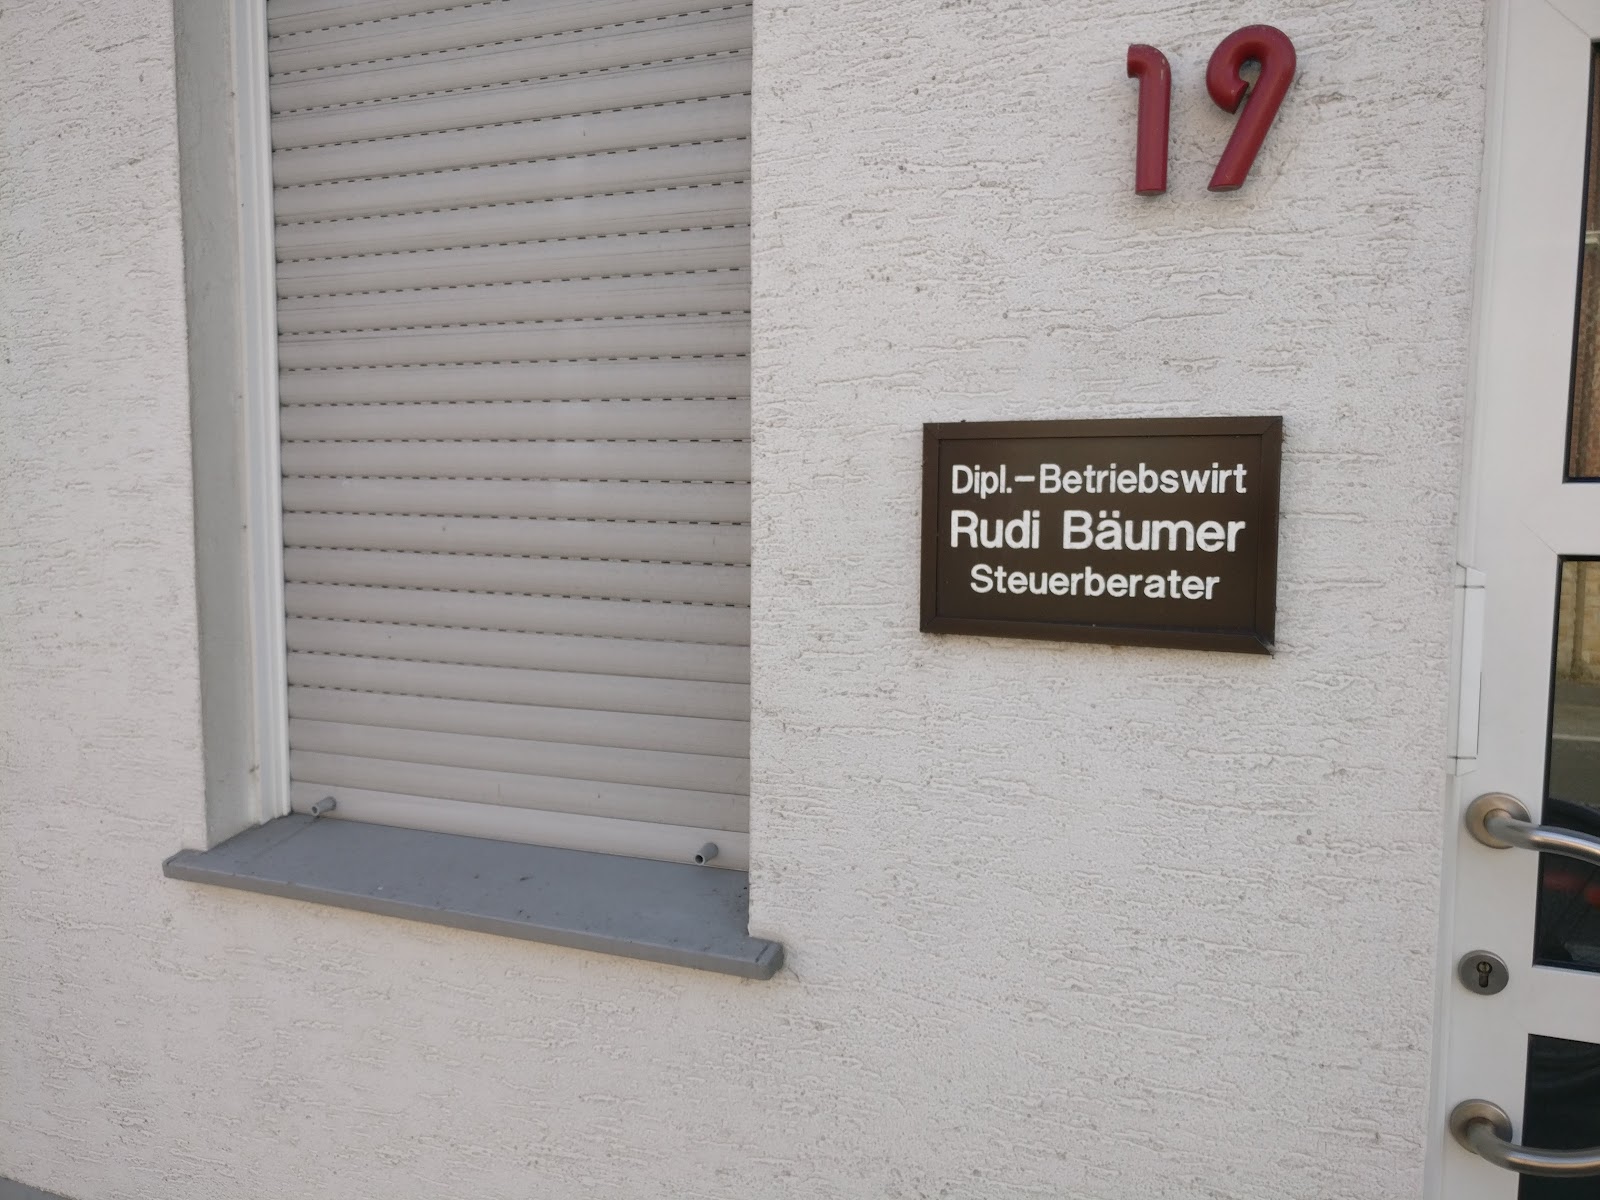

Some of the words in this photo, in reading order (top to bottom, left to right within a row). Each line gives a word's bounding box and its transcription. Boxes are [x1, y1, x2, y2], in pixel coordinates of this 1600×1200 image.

[1127, 24, 1297, 196] 19
[951, 462, 1248, 499] Dipl.-Betriebswirt
[950, 509, 1040, 549] Rudi
[1062, 510, 1246, 553] Bäumer
[970, 563, 1220, 600] Steuerberater
